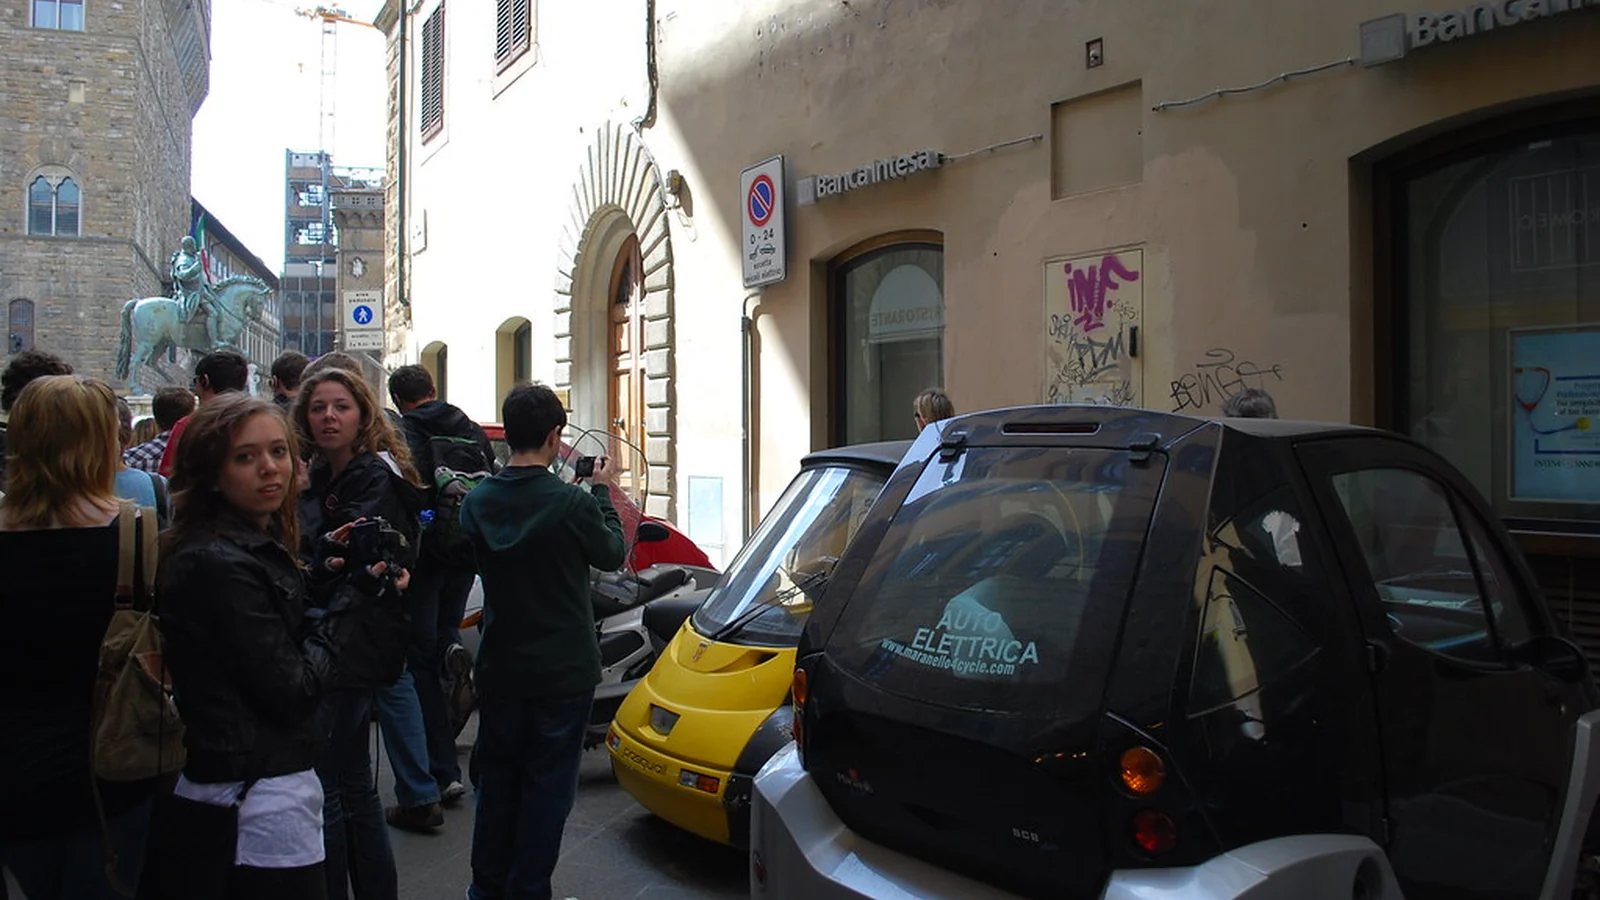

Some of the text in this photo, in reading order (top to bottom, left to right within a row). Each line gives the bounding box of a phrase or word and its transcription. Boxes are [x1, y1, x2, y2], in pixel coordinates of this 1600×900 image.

[763, 228, 774, 240] 24
[935, 608, 1002, 632] AUTO
[881, 638, 1015, 675] www.maranello4cycle.com
[911, 628, 1039, 664] ELETTRICA
